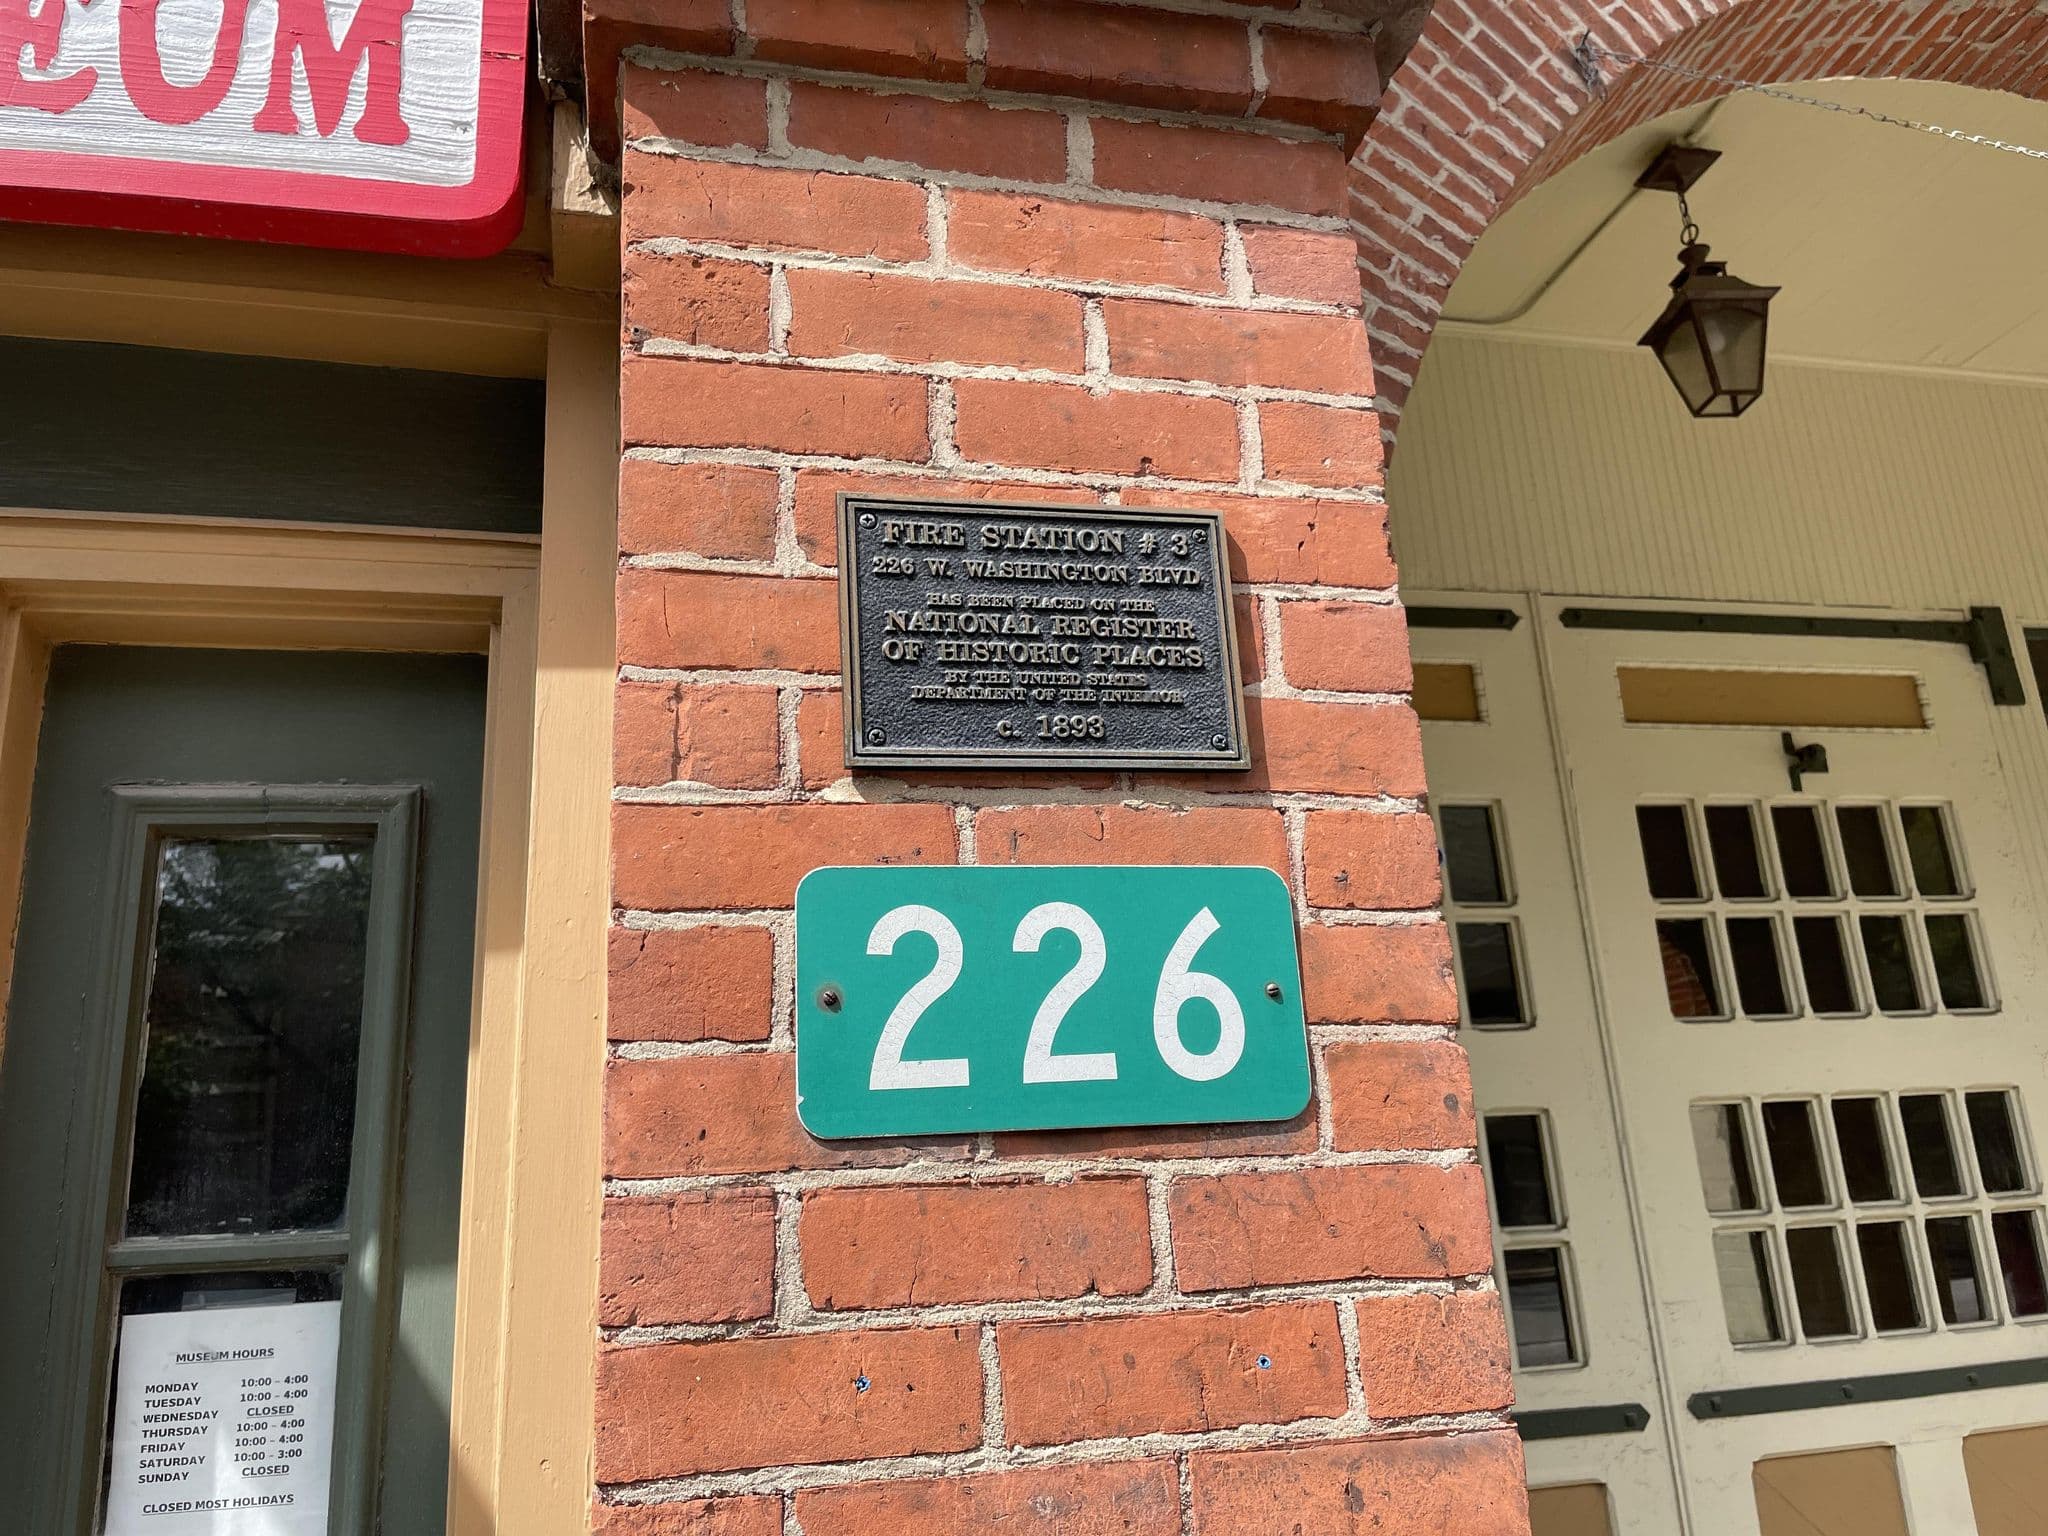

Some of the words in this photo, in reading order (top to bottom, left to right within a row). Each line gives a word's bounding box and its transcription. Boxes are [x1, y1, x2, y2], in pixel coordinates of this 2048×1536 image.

[882, 520, 964, 547] FIRE
[982, 526, 1124, 553] STATION
[1139, 534, 1156, 555] #
[1172, 535, 1188, 556] 3
[872, 556, 914, 575] 226
[925, 558, 953, 577] W.
[964, 560, 1128, 583] WASHINGTON
[1138, 567, 1201, 585] BLVD
[927, 593, 961, 607] HAS
[968, 595, 1014, 608] BEEN
[1020, 596, 1085, 610] PLACED
[1091, 599, 1117, 611] ON
[1123, 600, 1155, 613] THE
[884, 611, 1041, 635] NATIONAL
[1051, 616, 1195, 639] REGISTER
[882, 640, 924, 661] OF
[936, 641, 1081, 665] HISTORIC
[1094, 645, 1204, 668] PLACES
[945, 671, 970, 684] BY
[975, 672, 1009, 685] THE
[1018, 672, 1082, 686] UNITED
[1087, 674, 1148, 687] STATES
[911, 686, 1027, 702] DEPARTMENT
[1033, 688, 1055, 701] OF
[1060, 689, 1097, 703] THE
[1038, 716, 1105, 738] 1893
[866, 902, 1246, 1091] 226
[176, 1351, 229, 1363] MUSEUM
[232, 1348, 274, 1359] HOURS
[145, 1382, 199, 1393] MONDAY
[241, 1378, 271, 1387] 10:00
[284, 1375, 308, 1384] 4:00
[145, 1397, 201, 1408] TUESDAY
[240, 1392, 271, 1402] 10:00
[284, 1389, 308, 1399] 4:00
[143, 1411, 219, 1423] WEDNESDAY
[247, 1406, 294, 1416] CLOSED
[142, 1426, 208, 1438] THURSDAY
[237, 1422, 268, 1432] 10:00
[280, 1419, 305, 1428] 4:00
[141, 1442, 185, 1453] FRIDAY
[235, 1437, 266, 1447] 10:00
[279, 1434, 303, 1443] 4:00
[139, 1456, 206, 1468] SATURDAY
[234, 1452, 265, 1462] 10:00
[278, 1449, 302, 1458] 3:00
[138, 1472, 189, 1484] SUNDAY
[242, 1465, 289, 1476] CLOSED
[143, 1502, 191, 1514] CLOSED
[195, 1499, 229, 1510] MOST
[233, 1494, 294, 1507] HOLIDAYS
